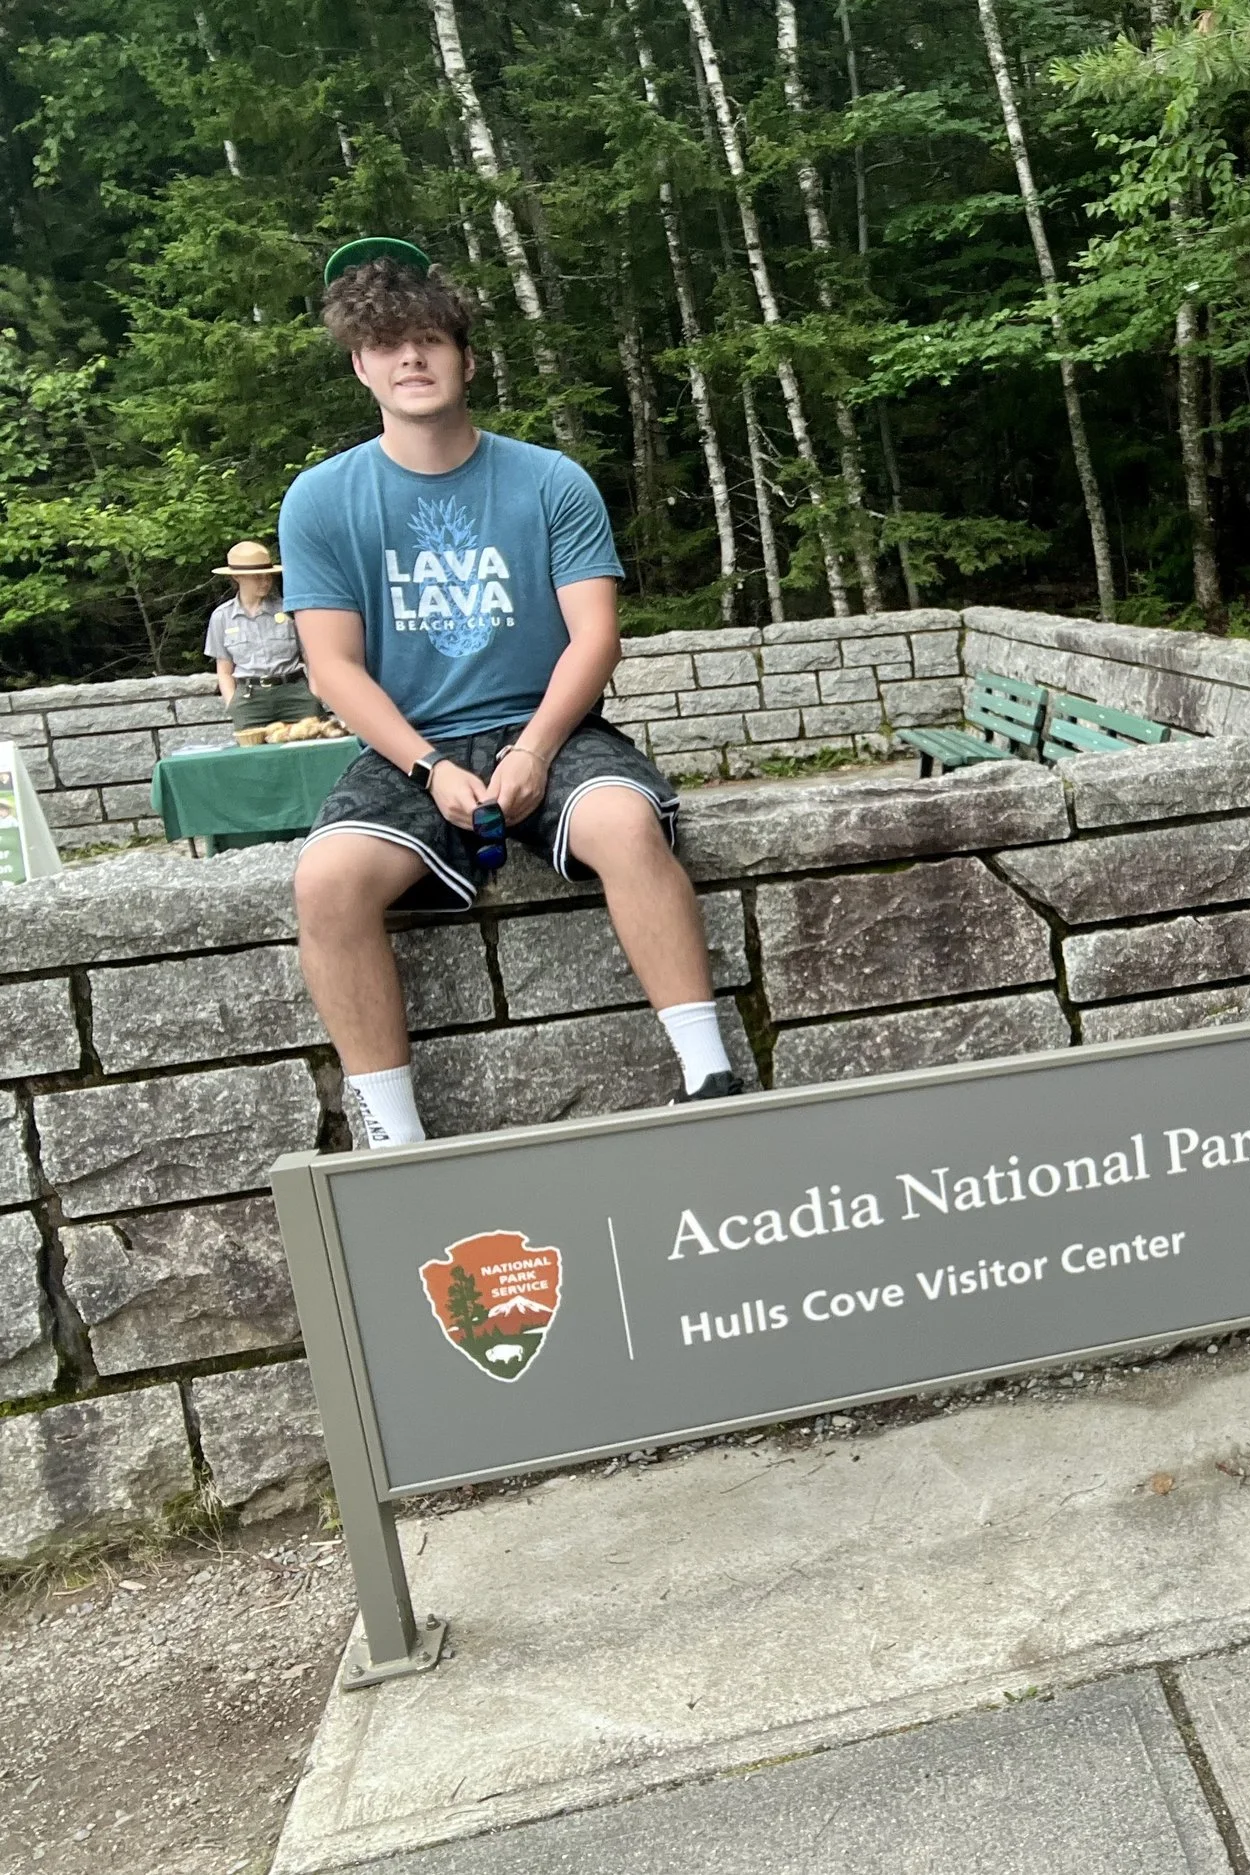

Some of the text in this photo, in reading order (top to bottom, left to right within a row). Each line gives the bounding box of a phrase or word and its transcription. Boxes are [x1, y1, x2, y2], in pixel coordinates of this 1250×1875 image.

[385, 546, 510, 583] LAVA
[390, 581, 513, 619] LAVA
[395, 616, 515, 631] BEACH CLUB
[666, 1185, 886, 1262] Acadia
[895, 1133, 1152, 1222] National
[480, 1257, 551, 1276] NATIONAL
[499, 1270, 537, 1285] PARK
[490, 1279, 549, 1299] SERVICE
[680, 1230, 1187, 1346] Hulls Cove Visitor Center
